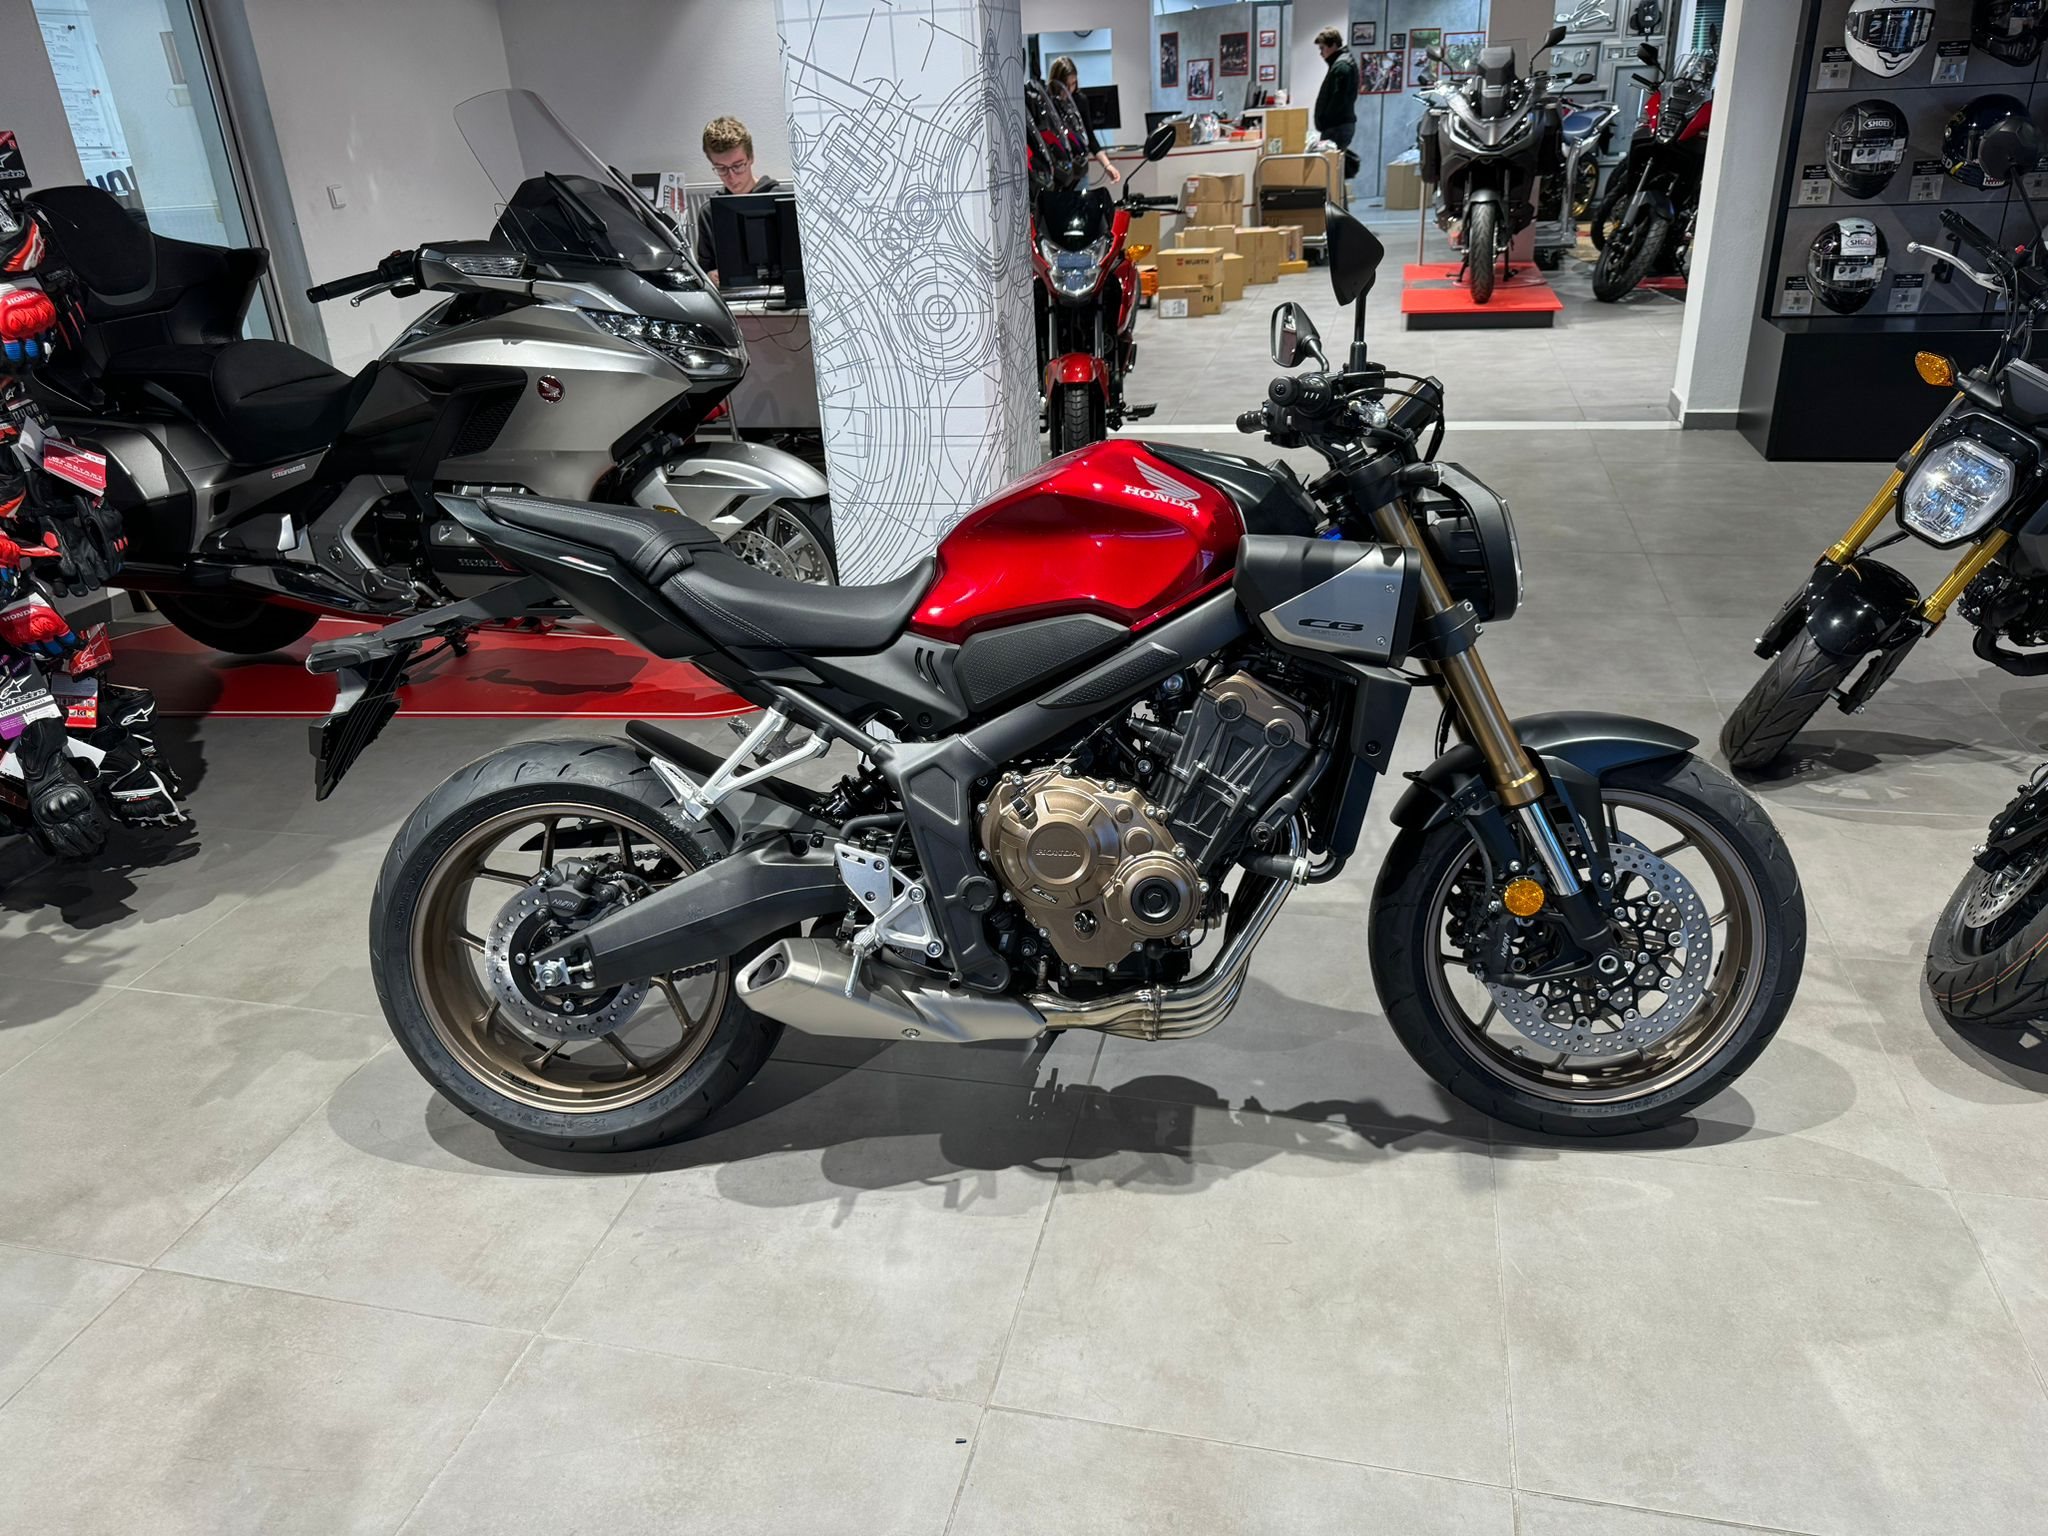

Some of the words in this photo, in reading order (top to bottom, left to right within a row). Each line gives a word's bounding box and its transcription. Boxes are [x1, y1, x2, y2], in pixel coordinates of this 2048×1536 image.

[1867, 120, 1890, 128] SHOEI
[6, 291, 39, 305] HONDA
[1121, 484, 1200, 517] HONDA
[457, 558, 503, 568] HOND
[2, 606, 38, 622] HONDA
[1298, 618, 1364, 632] CB
